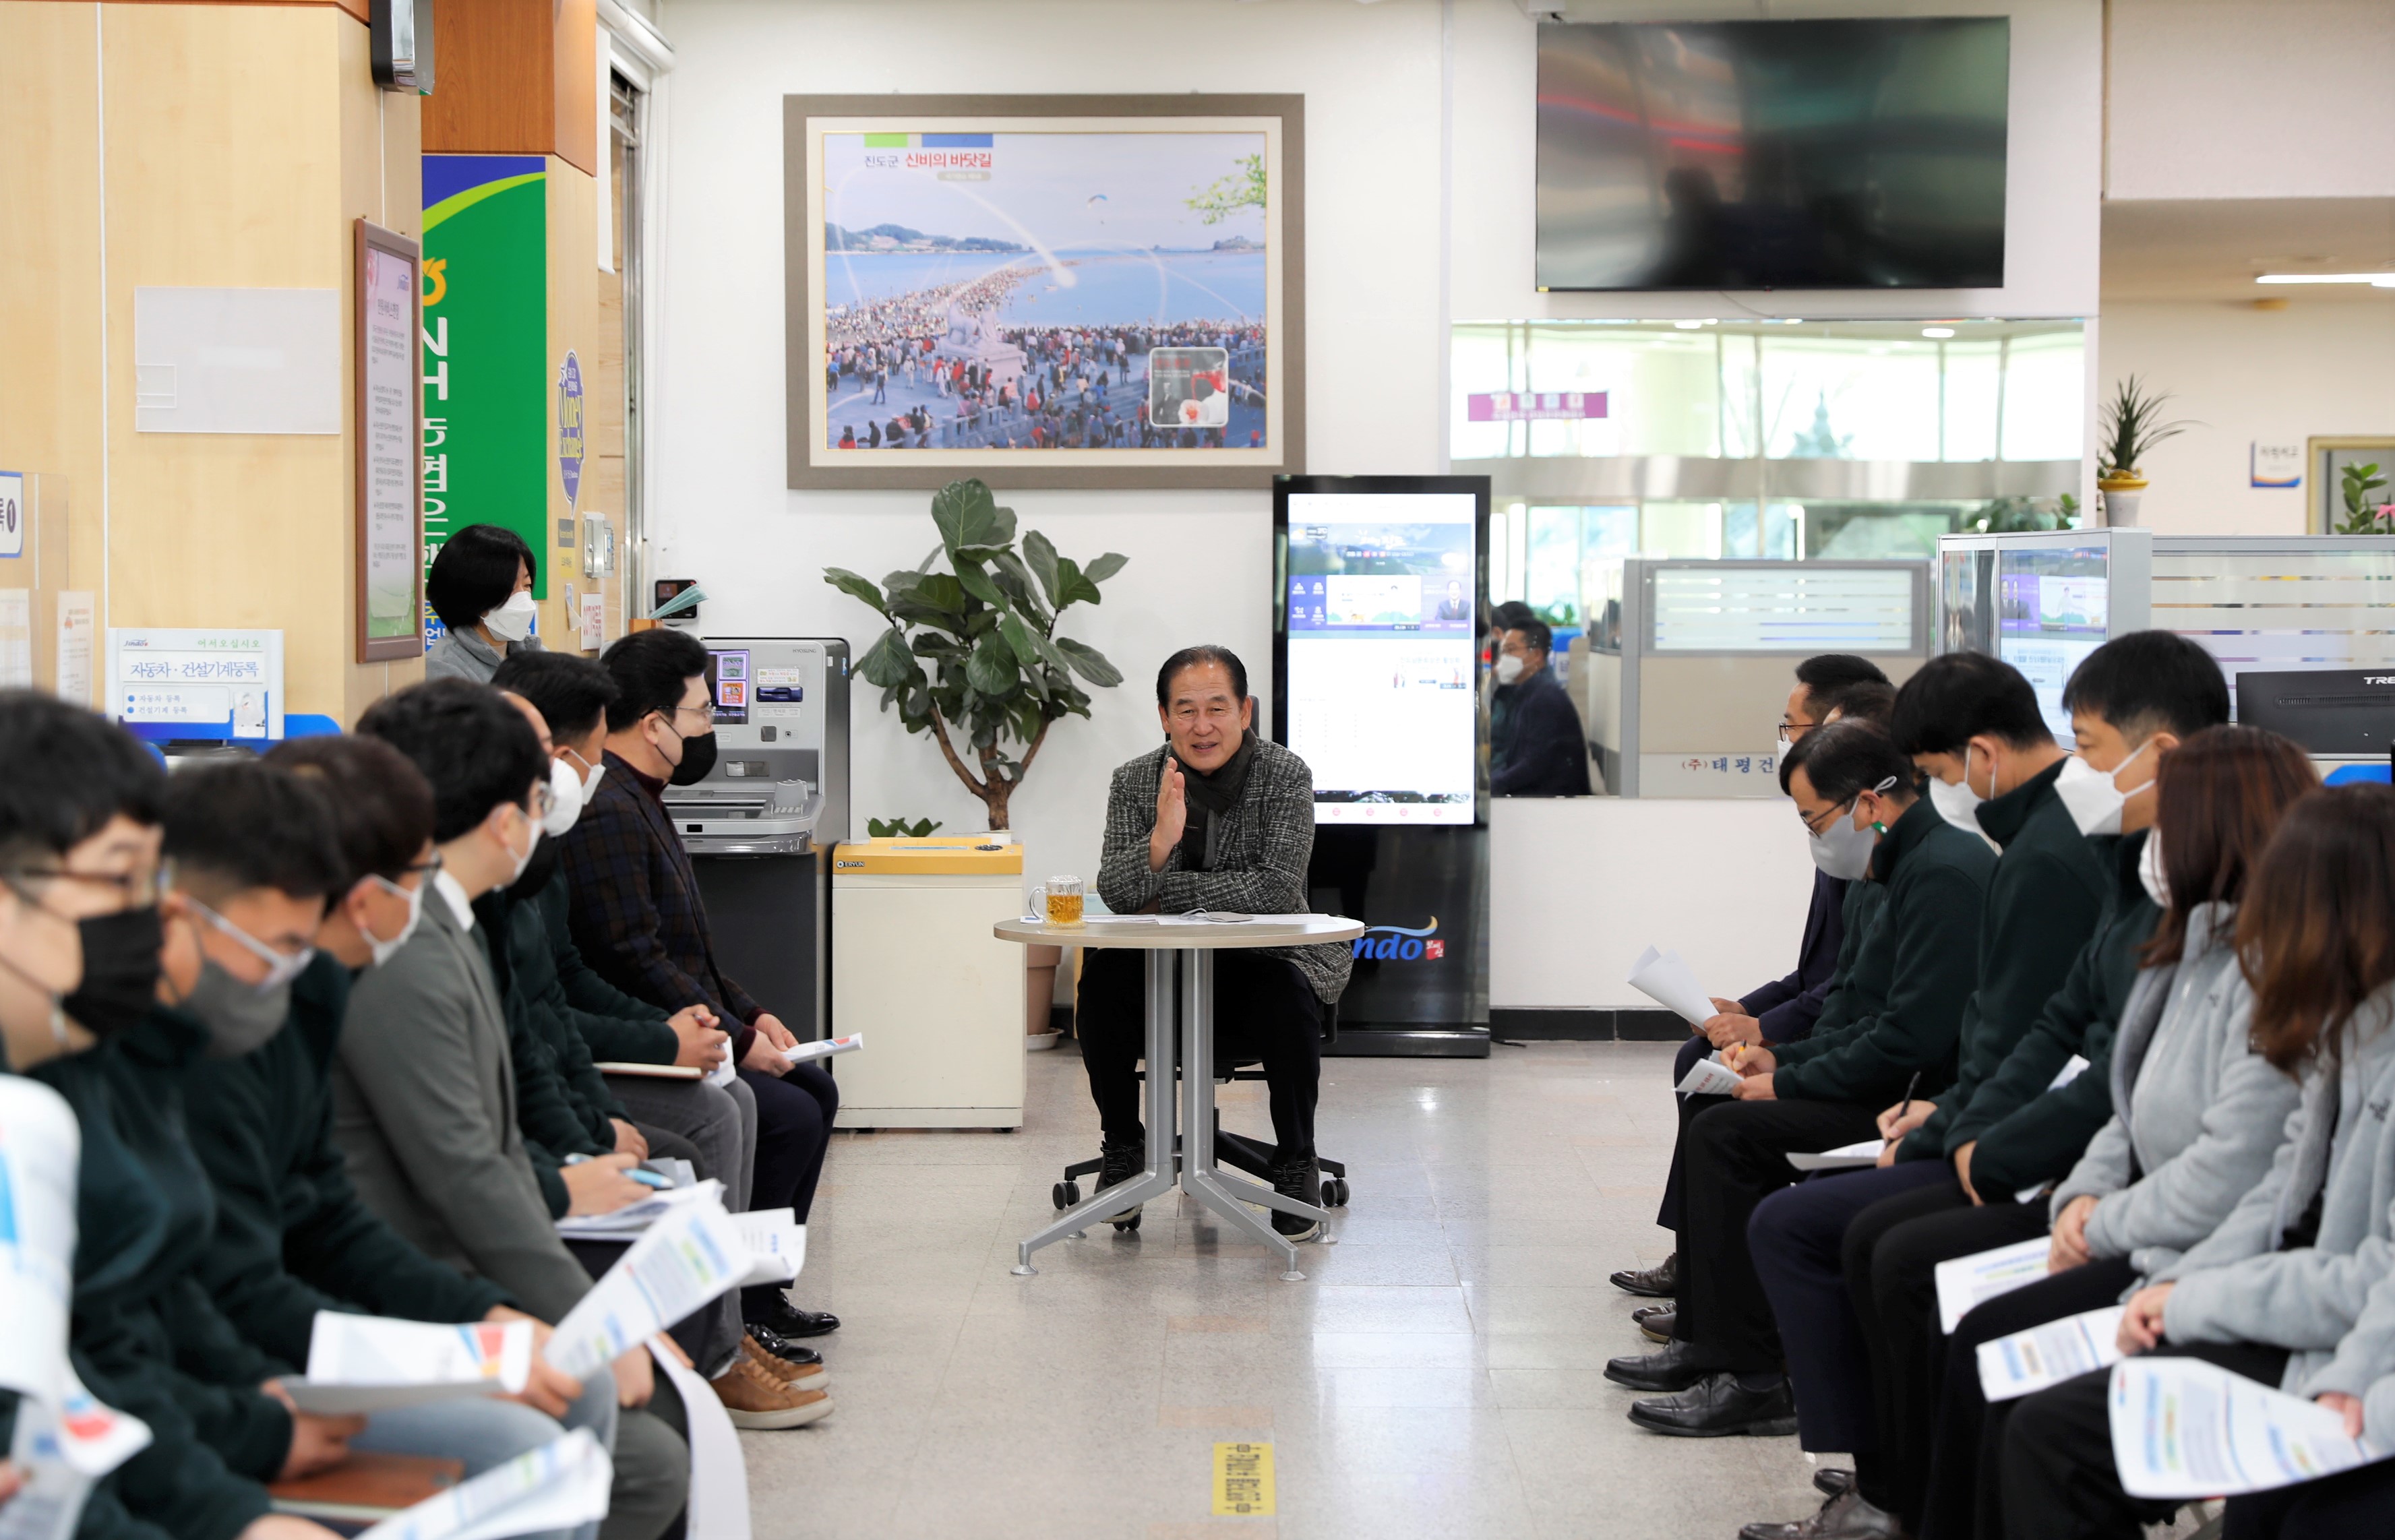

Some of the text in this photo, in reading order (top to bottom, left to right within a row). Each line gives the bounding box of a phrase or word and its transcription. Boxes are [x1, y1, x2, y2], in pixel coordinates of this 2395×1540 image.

[864, 152, 992, 168] 진도군 신비의 바닷길
[558, 386, 583, 435] Money
[198, 638, 261, 648] 어서오십시오
[130, 661, 260, 678] 자동차 건설기계등록
[139, 694, 162, 703] 자동차
[138, 706, 169, 714] 건설기계
